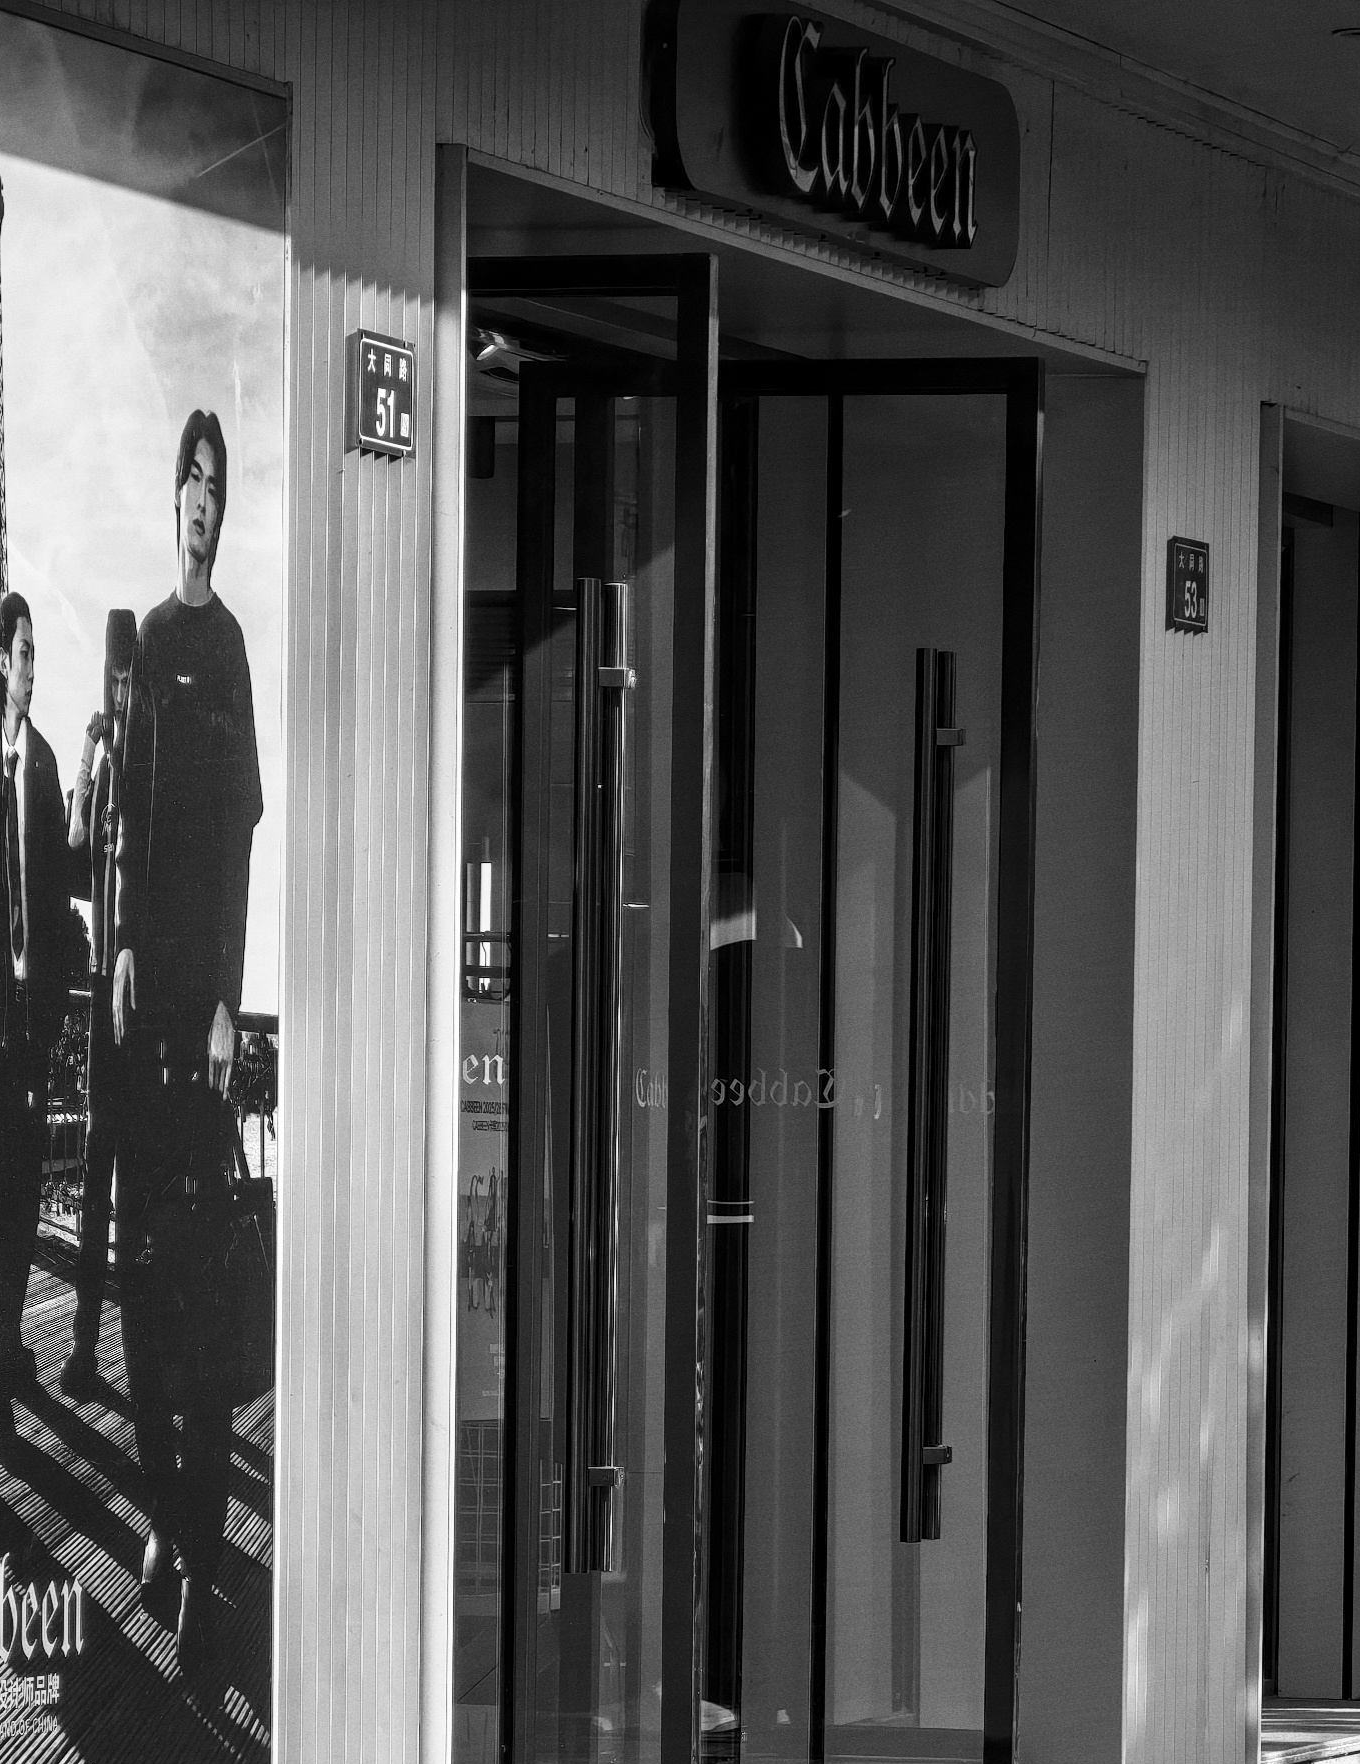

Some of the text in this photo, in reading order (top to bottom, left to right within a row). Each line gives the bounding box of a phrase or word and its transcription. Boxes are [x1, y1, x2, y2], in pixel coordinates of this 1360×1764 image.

[779, 15, 979, 248] Cabbeen
[367, 348, 408, 382] 大同路
[375, 387, 395, 438] 51
[1184, 580, 1198, 619] 53
[20, 1718, 31, 1736] OF
[32, 1715, 58, 1734] CHINA
